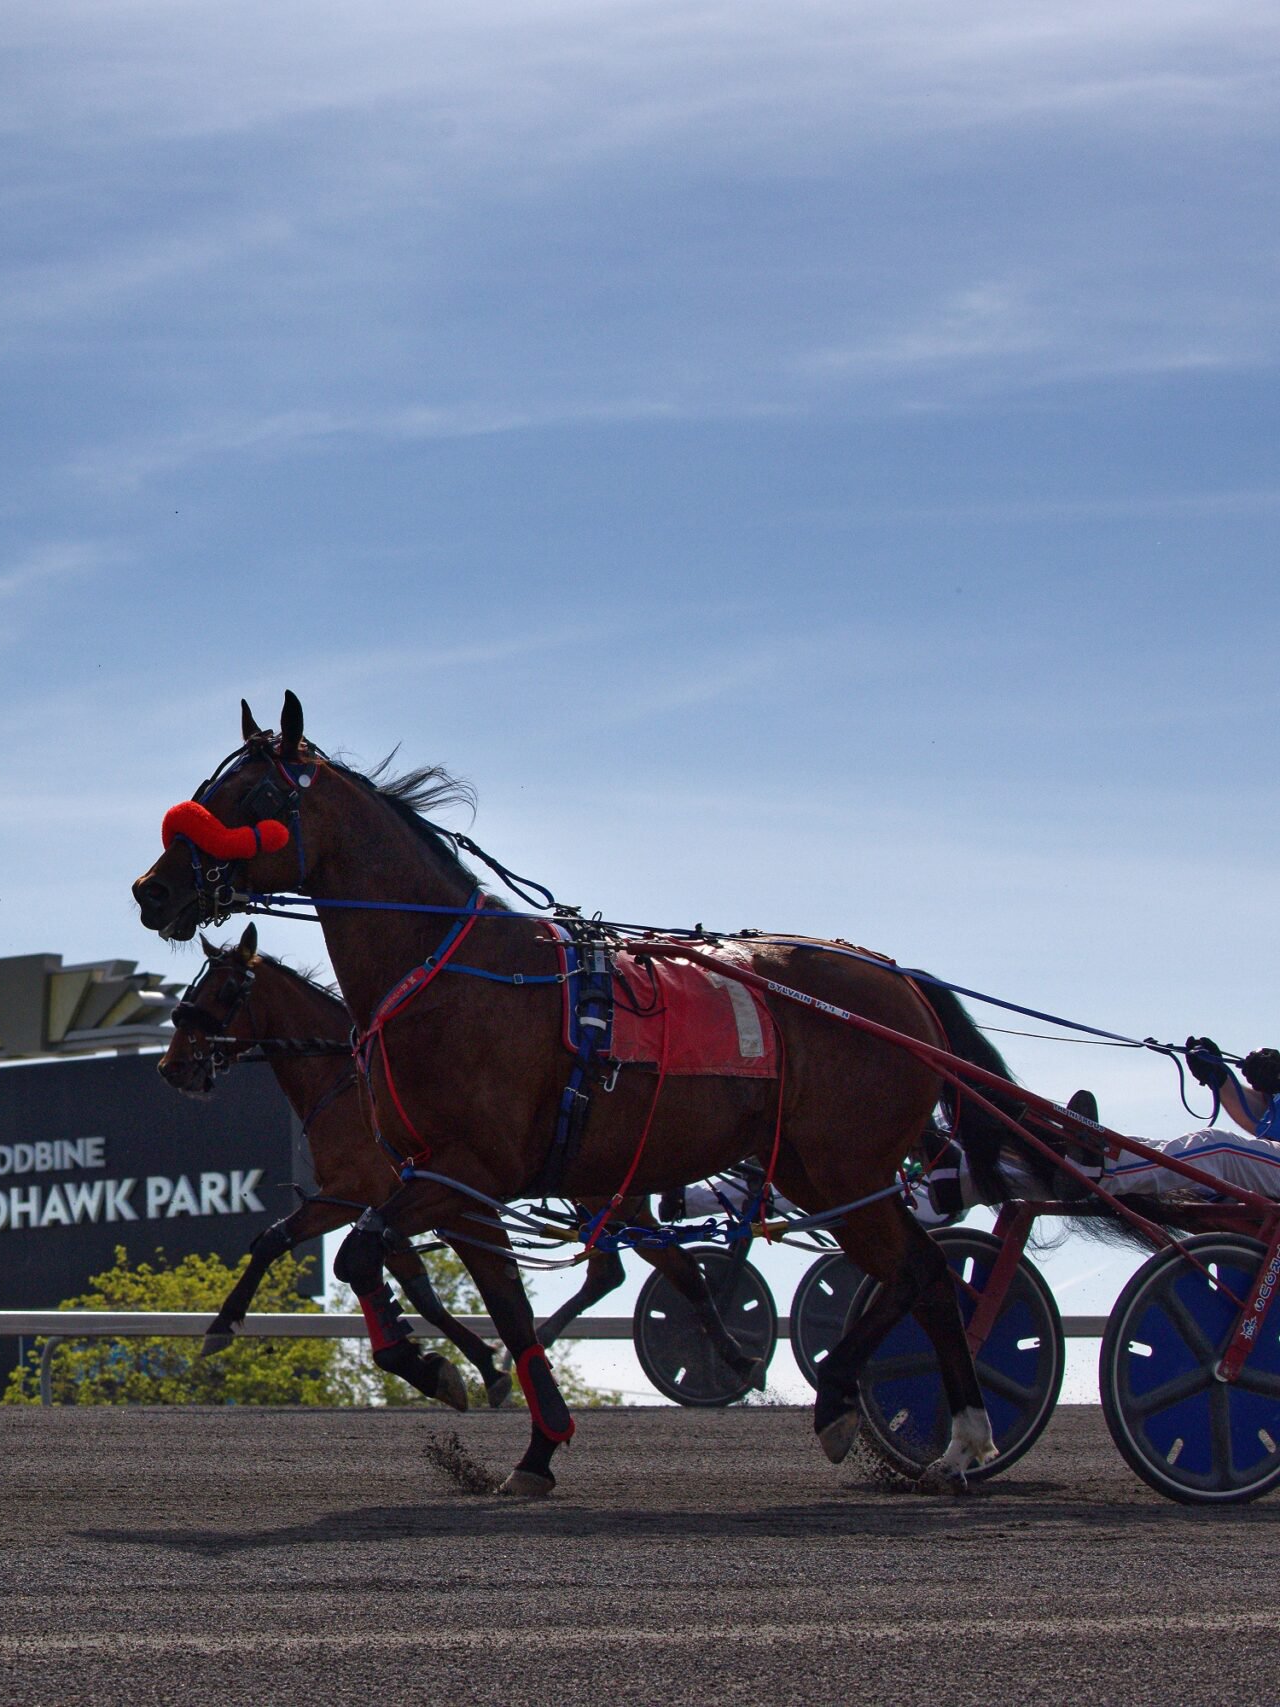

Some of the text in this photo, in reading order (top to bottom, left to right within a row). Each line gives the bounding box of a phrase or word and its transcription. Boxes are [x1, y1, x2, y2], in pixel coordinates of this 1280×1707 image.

[706, 970, 765, 1057] 1
[768, 981, 812, 1004] SYLVAIN
[146, 1168, 267, 1220] PARK
